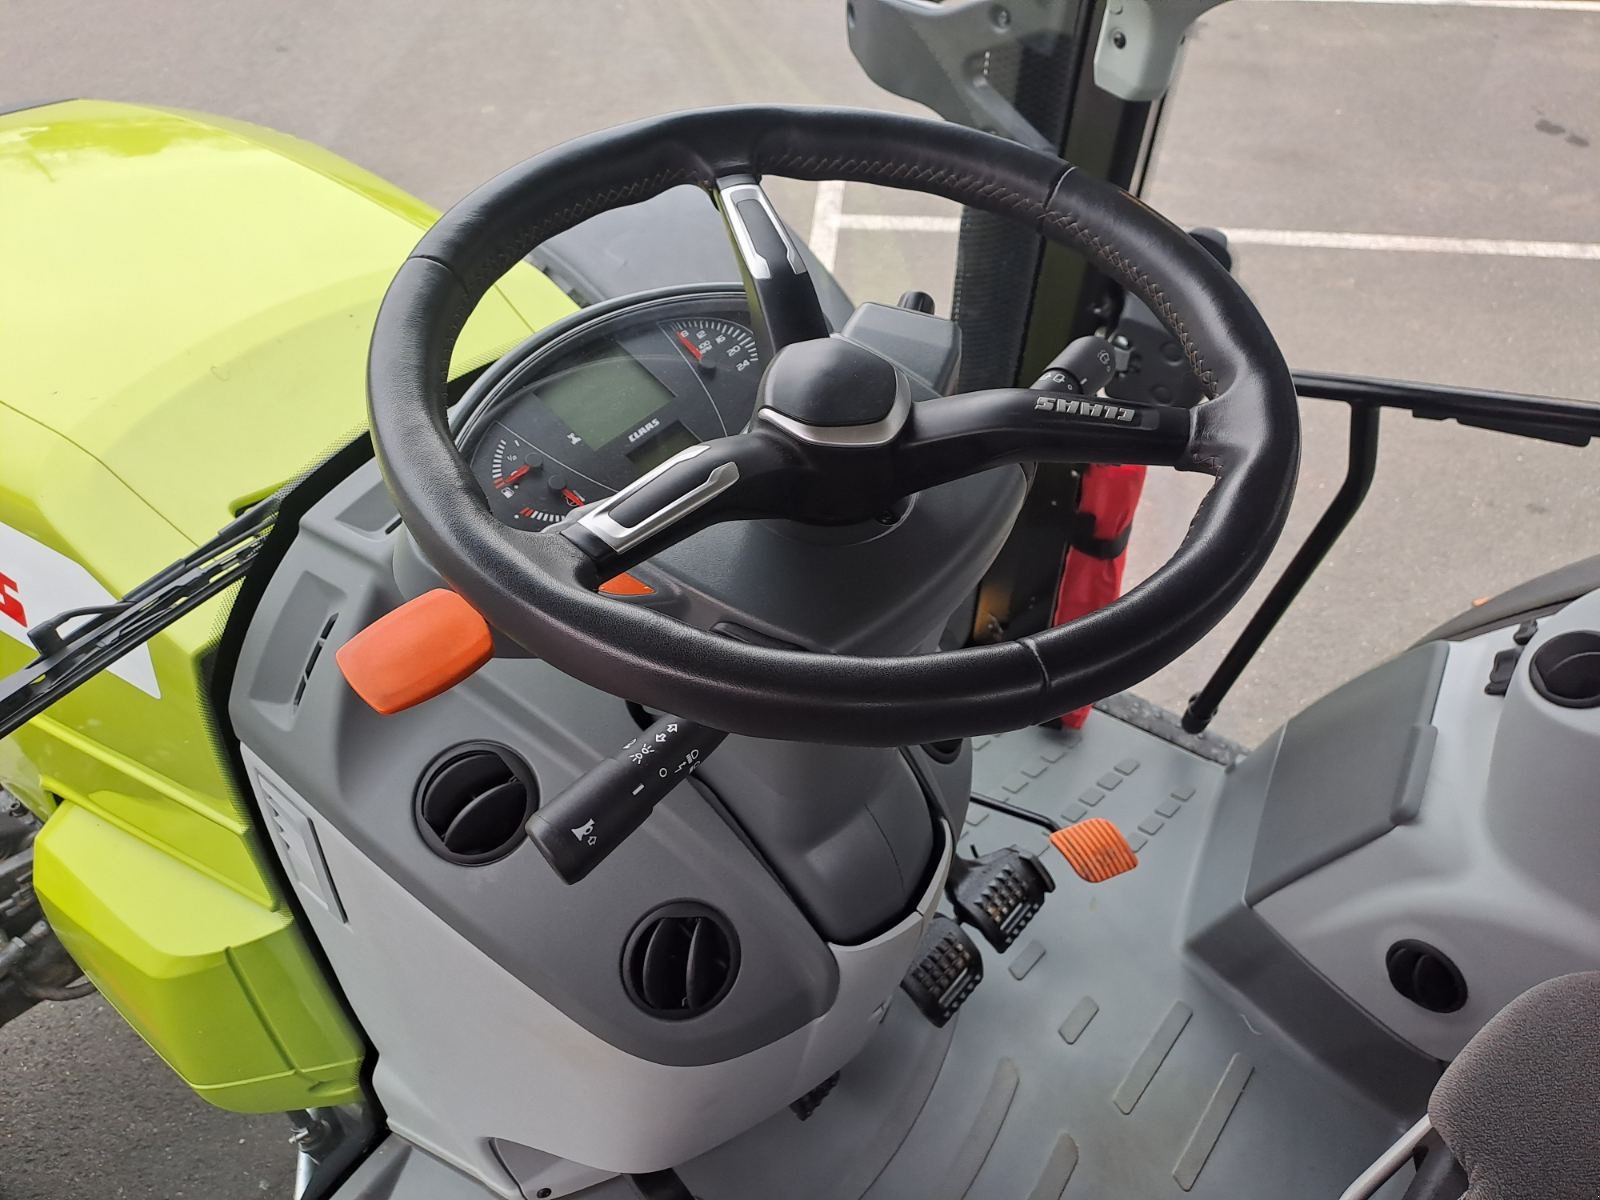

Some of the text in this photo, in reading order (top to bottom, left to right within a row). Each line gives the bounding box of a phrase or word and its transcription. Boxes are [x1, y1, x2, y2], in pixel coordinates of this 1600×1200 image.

[680, 330, 689, 338] 8
[696, 330, 707, 339] 12
[715, 334, 726, 344] 16
[726, 345, 741, 357] 20
[736, 359, 750, 372] 24
[1034, 396, 1136, 422] CLAAS
[628, 417, 660, 443] CLAAS
